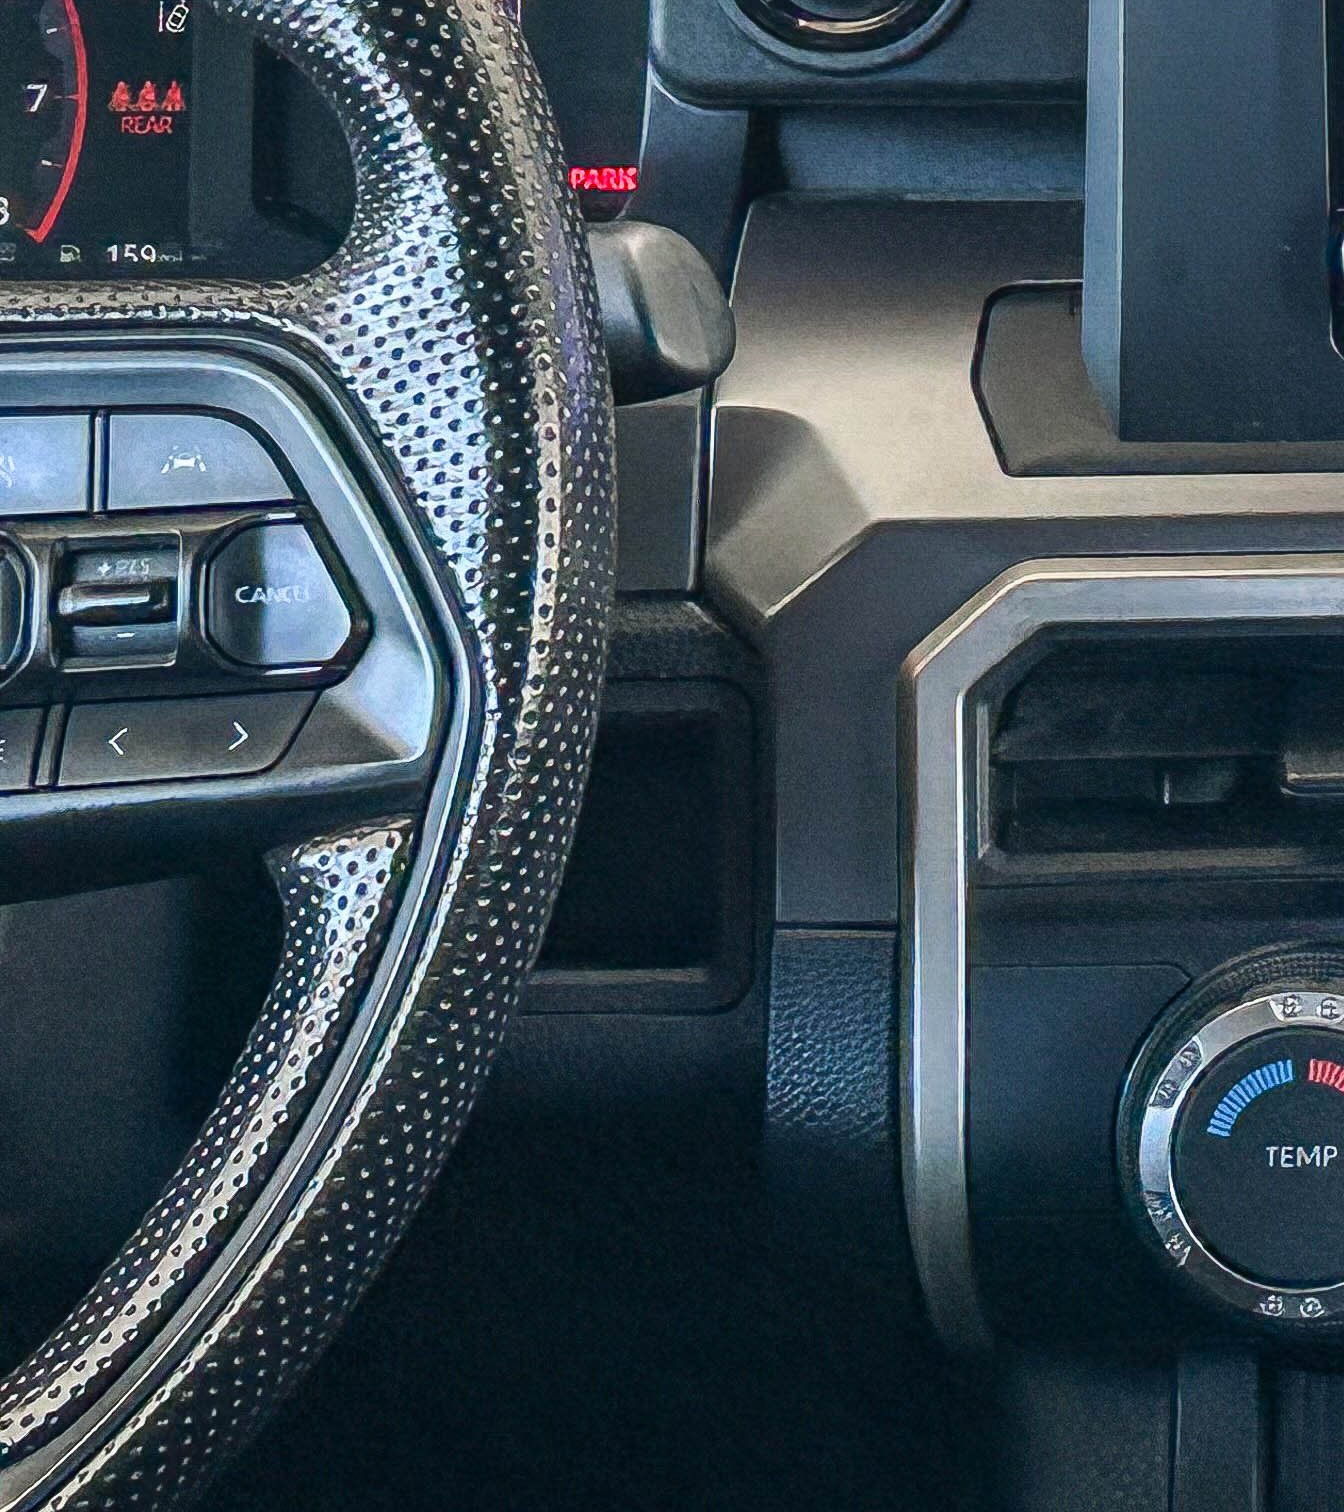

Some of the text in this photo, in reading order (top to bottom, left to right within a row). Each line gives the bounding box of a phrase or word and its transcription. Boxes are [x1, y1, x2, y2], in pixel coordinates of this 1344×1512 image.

[24, 83, 48, 112] 7
[120, 115, 173, 134] REAR
[106, 243, 156, 263] 159
[1265, 1145, 1339, 1168] TEMP
